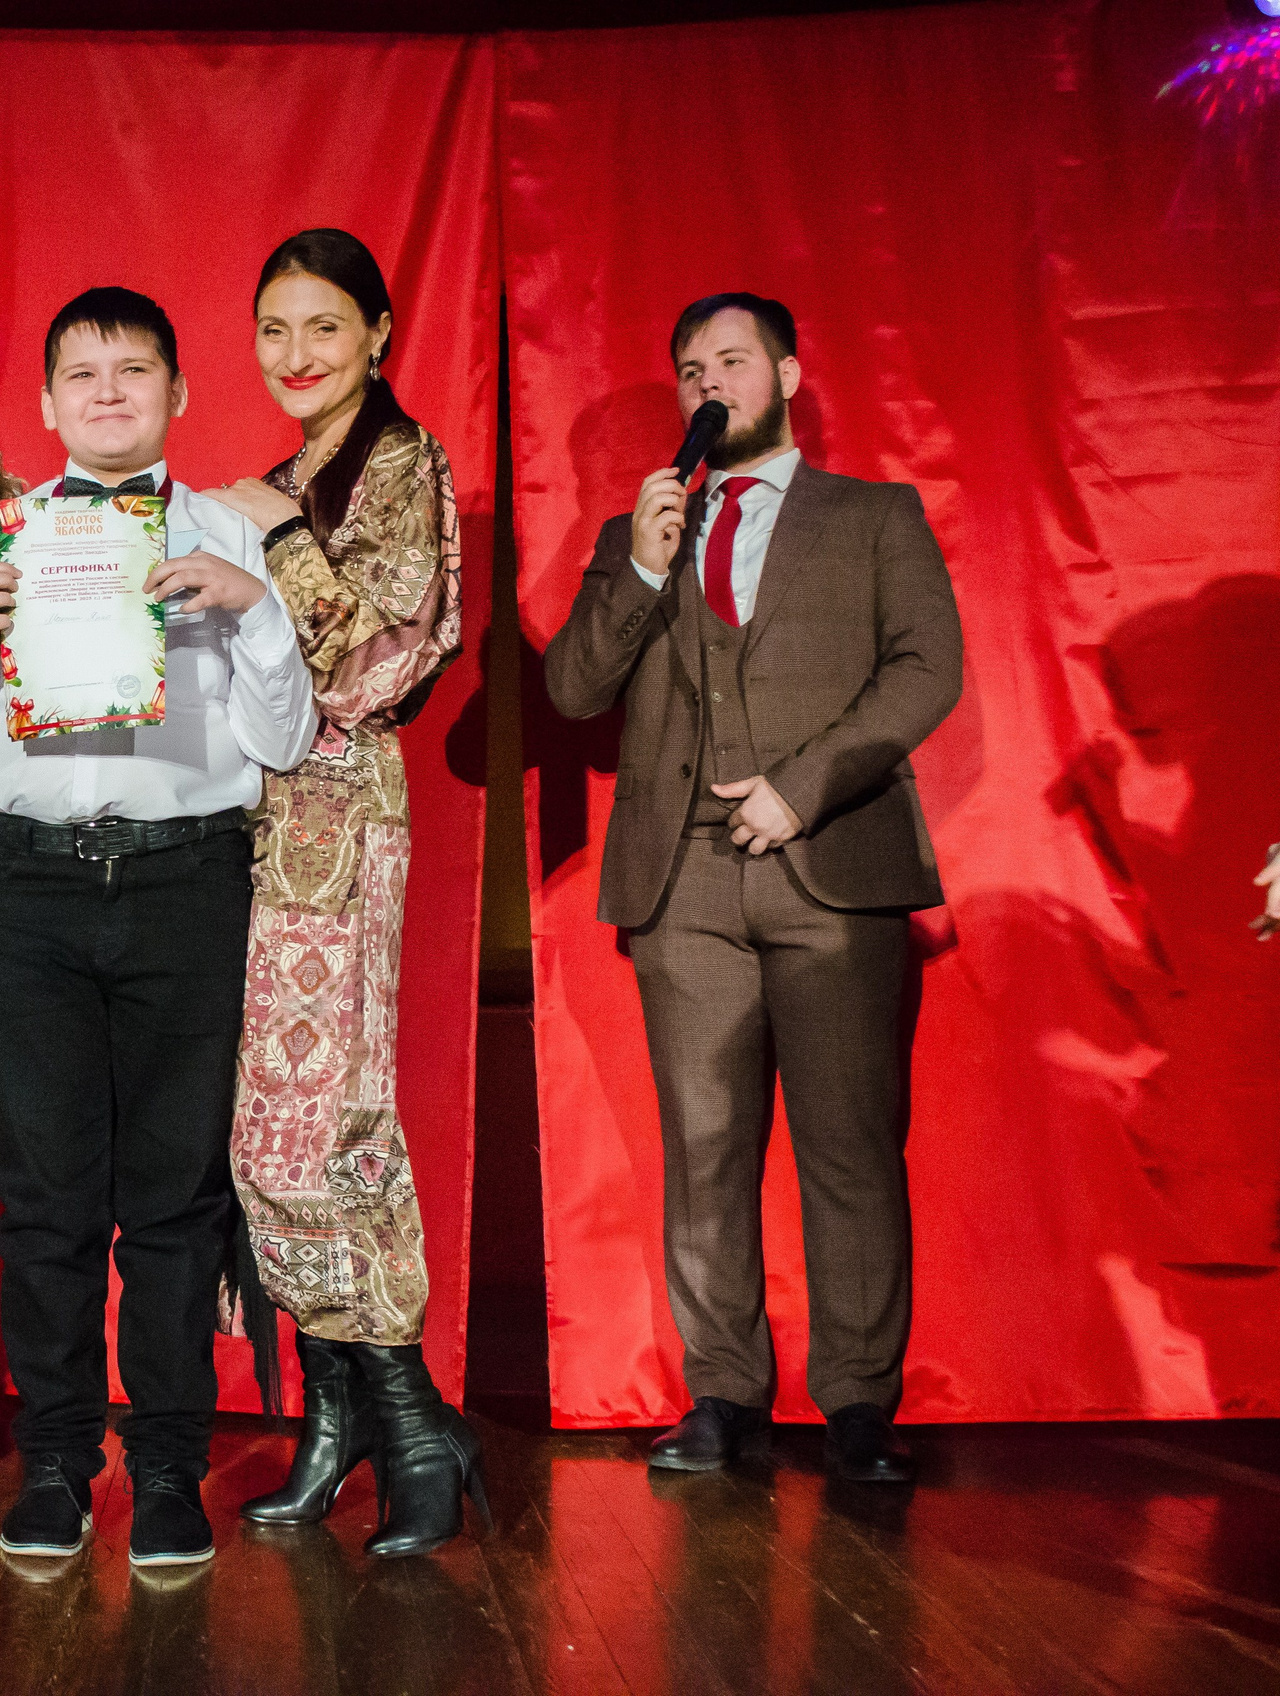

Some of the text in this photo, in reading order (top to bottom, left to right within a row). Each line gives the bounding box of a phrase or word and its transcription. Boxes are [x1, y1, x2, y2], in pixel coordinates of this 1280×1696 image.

[54, 514, 103, 526] ЗОЛОТОЕ
[54, 524, 104, 536] ЯБЛОЧКО
[40, 563, 120, 575] СЕРТИФИКАТ
